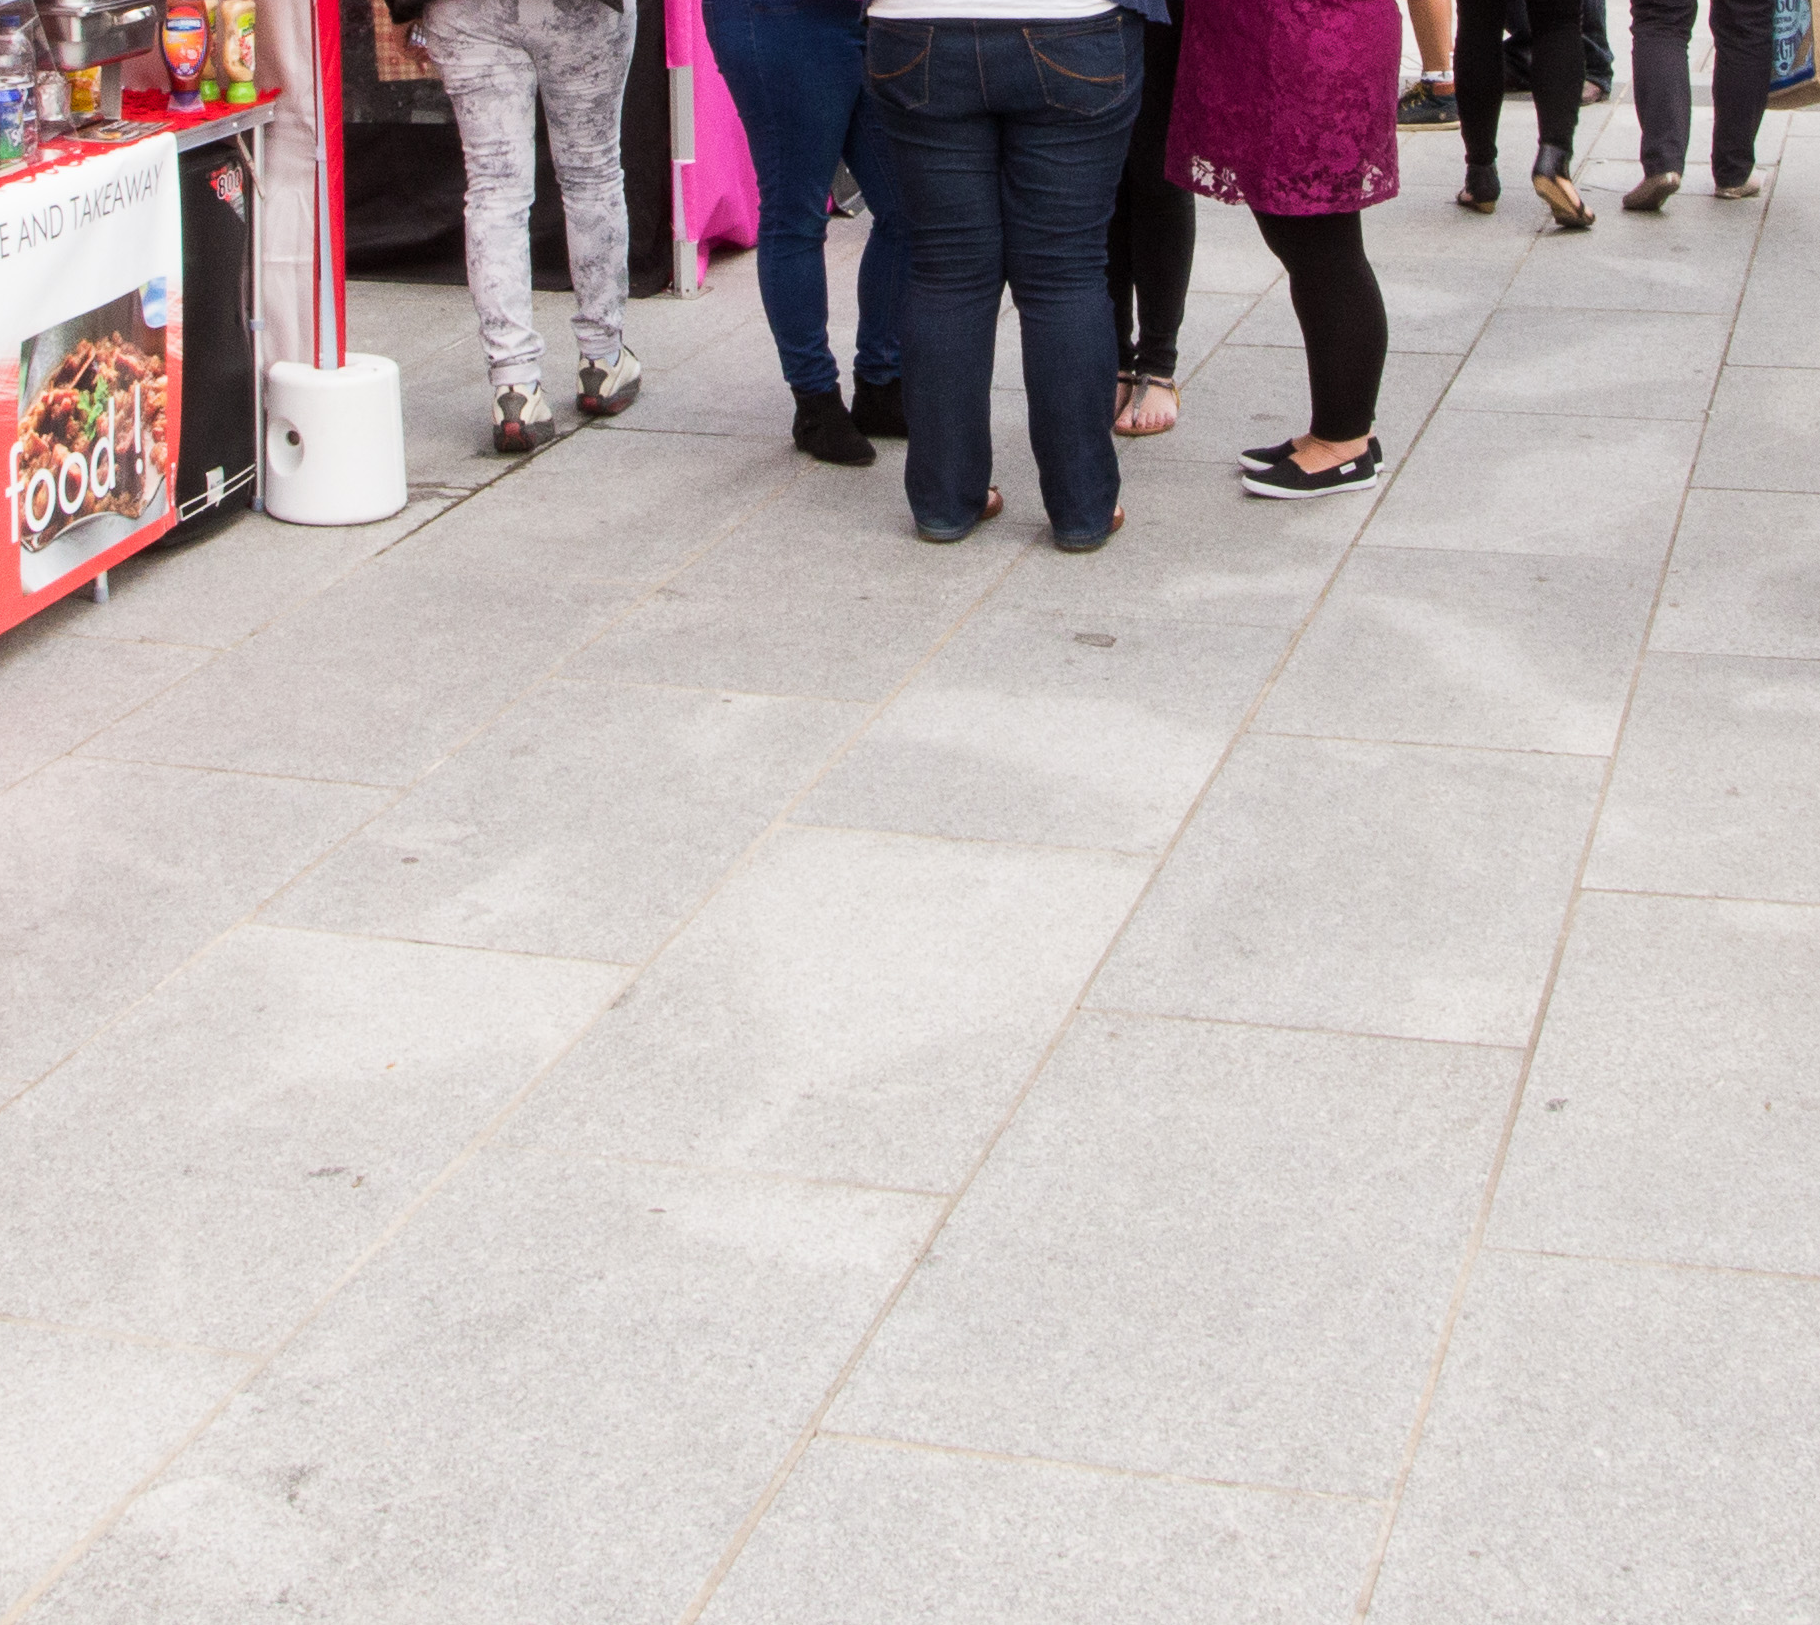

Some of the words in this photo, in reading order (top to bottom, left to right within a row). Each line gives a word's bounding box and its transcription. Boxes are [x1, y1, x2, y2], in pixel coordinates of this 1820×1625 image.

[17, 204, 65, 254] AND
[69, 160, 165, 231] TAKEAWAY
[216, 164, 244, 201] 800
[5, 396, 117, 544] food
[129, 379, 146, 477] !
